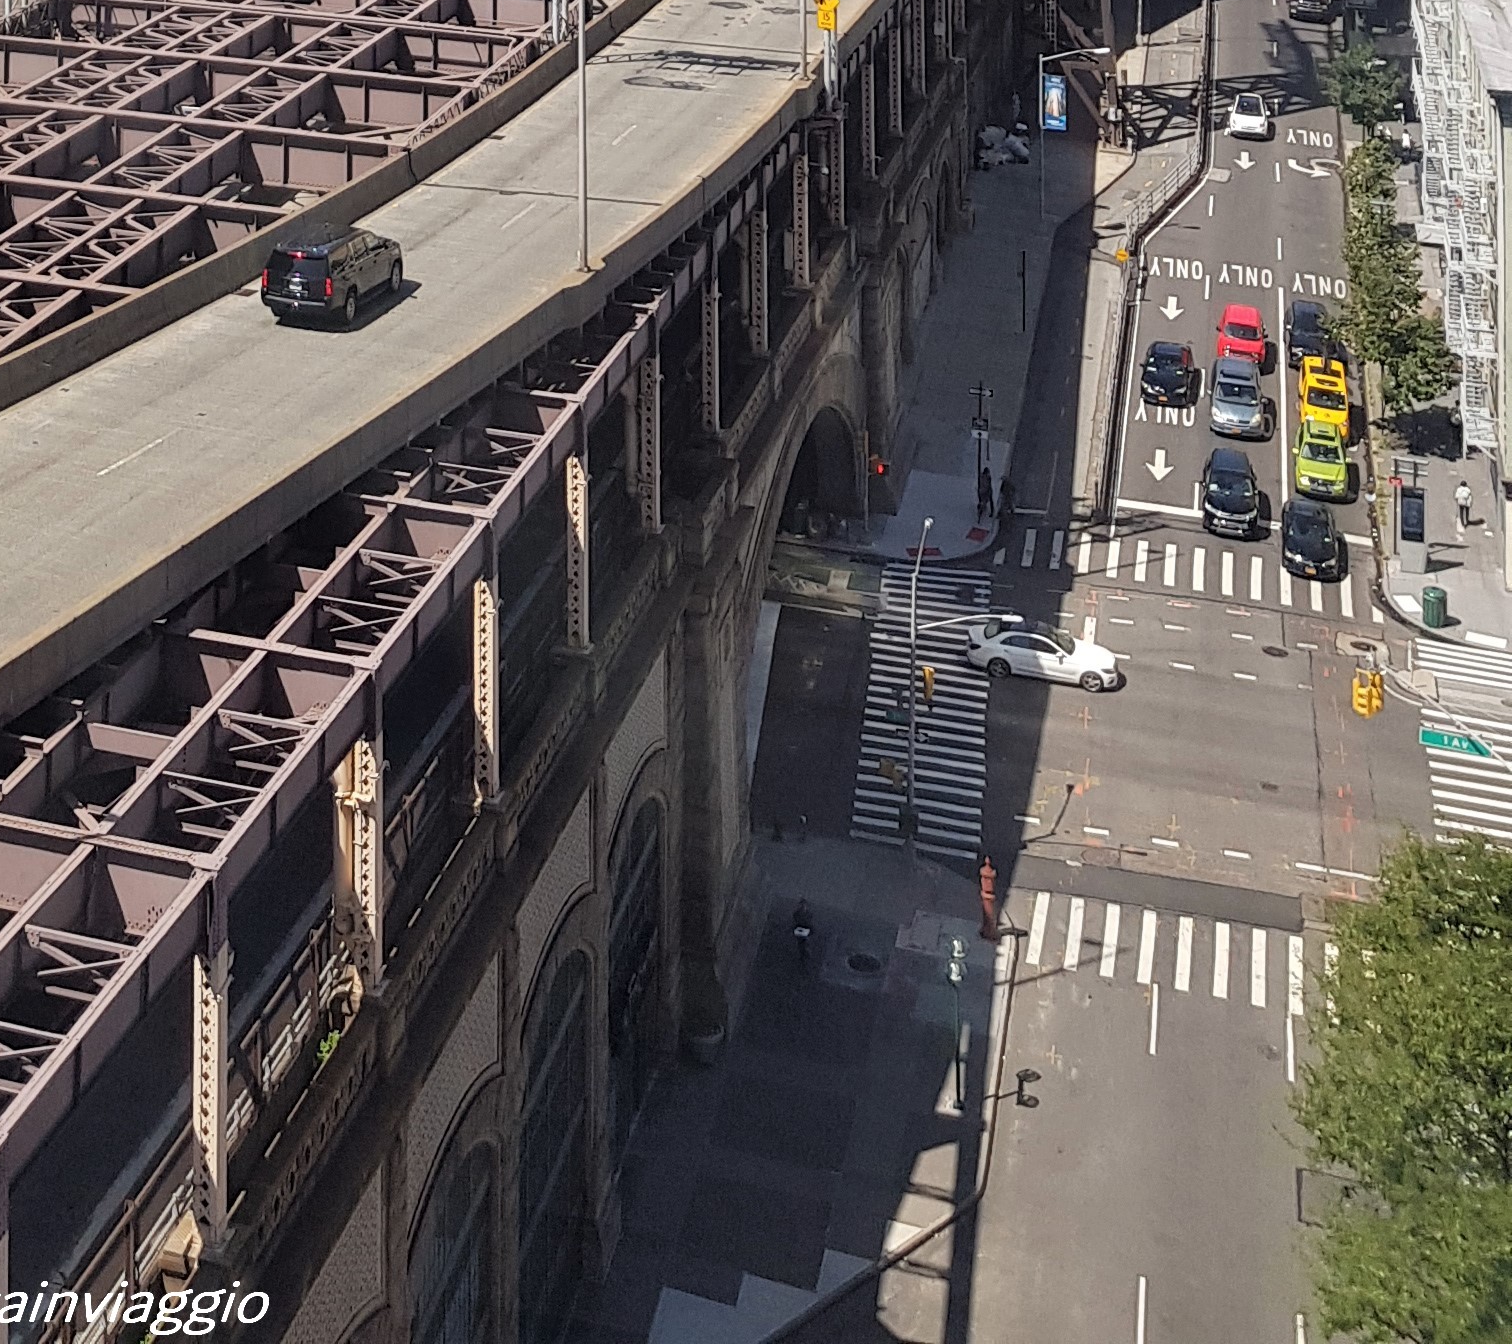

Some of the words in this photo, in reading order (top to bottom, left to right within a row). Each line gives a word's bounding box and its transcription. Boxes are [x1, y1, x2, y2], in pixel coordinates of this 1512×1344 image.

[1285, 128, 1334, 149] ONLY
[1149, 256, 1204, 280] ONLY
[1219, 263, 1273, 289] ONLY
[1292, 272, 1348, 299] ONLY
[1443, 735, 1448, 745] 1
[1451, 737, 1469, 749] AV
